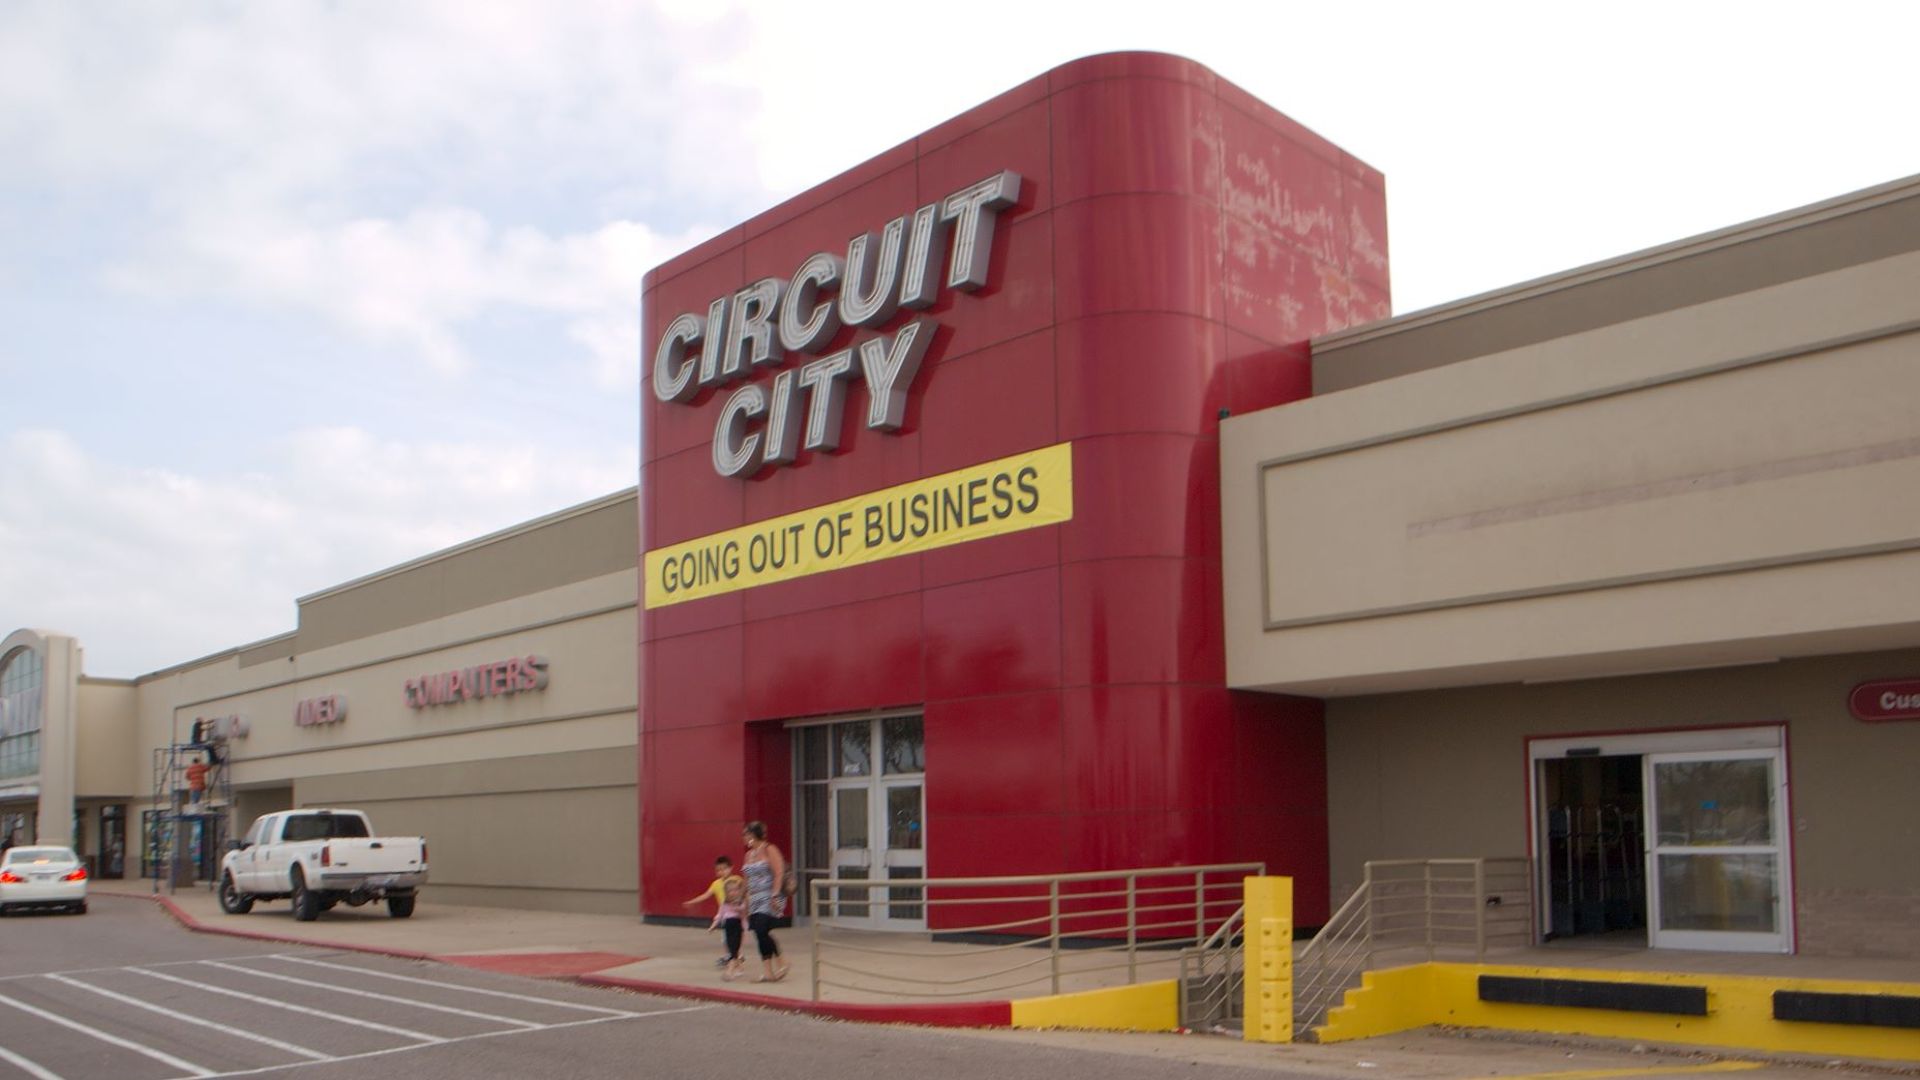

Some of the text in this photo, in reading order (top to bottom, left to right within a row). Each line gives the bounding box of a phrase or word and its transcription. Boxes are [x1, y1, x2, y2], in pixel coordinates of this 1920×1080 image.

[652, 169, 1022, 402] CIRCUIT
[712, 317, 939, 479] CITY
[662, 465, 1040, 594] GOING OUT OF BUSINESS
[402, 655, 548, 709] COMPUTERS
